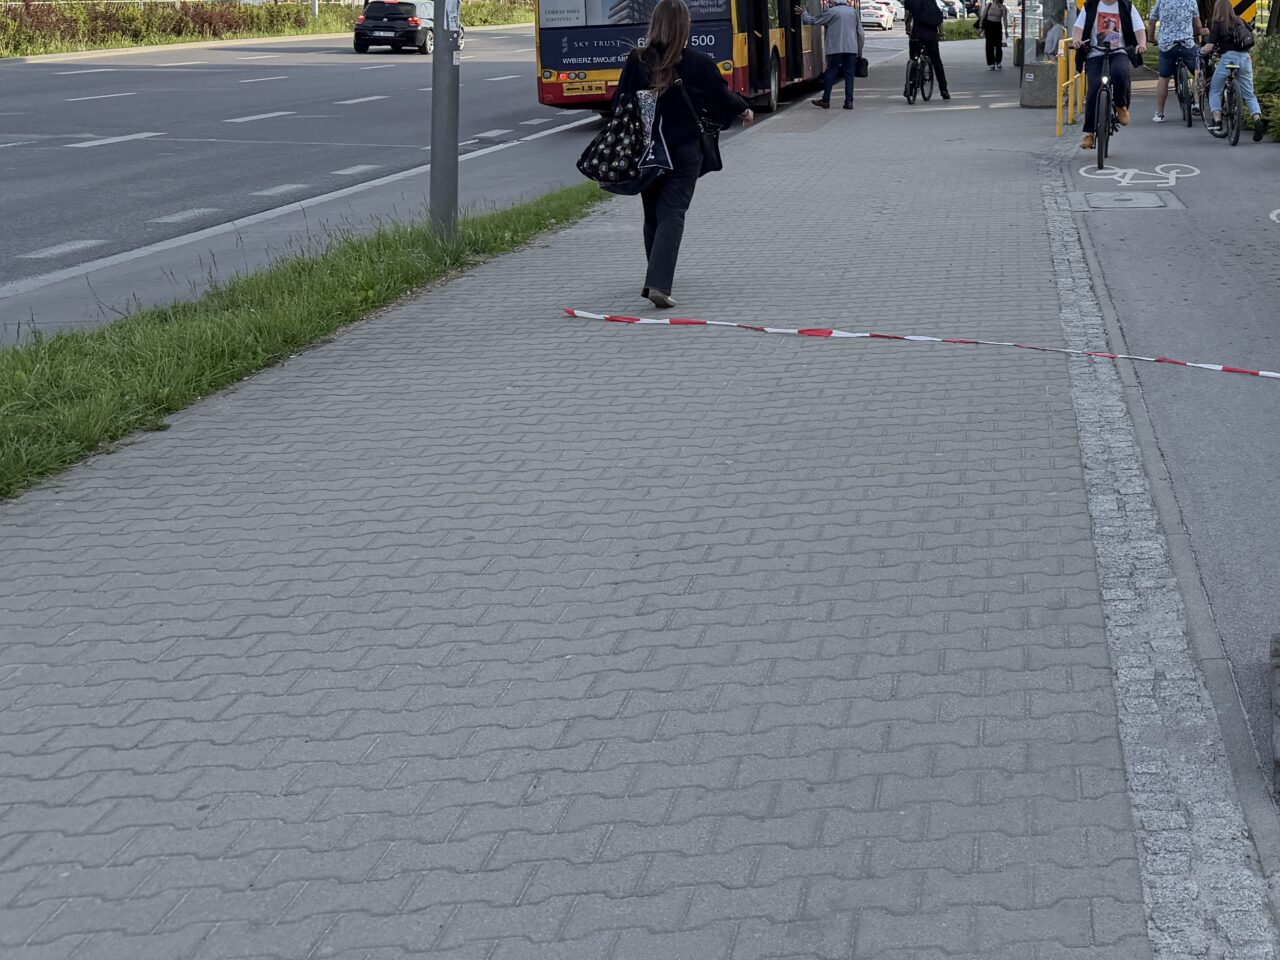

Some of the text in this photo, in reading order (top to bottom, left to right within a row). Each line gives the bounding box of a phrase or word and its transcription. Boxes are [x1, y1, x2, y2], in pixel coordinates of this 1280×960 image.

[573, 39, 621, 48] SKY TRUST
[691, 34, 715, 46] 500
